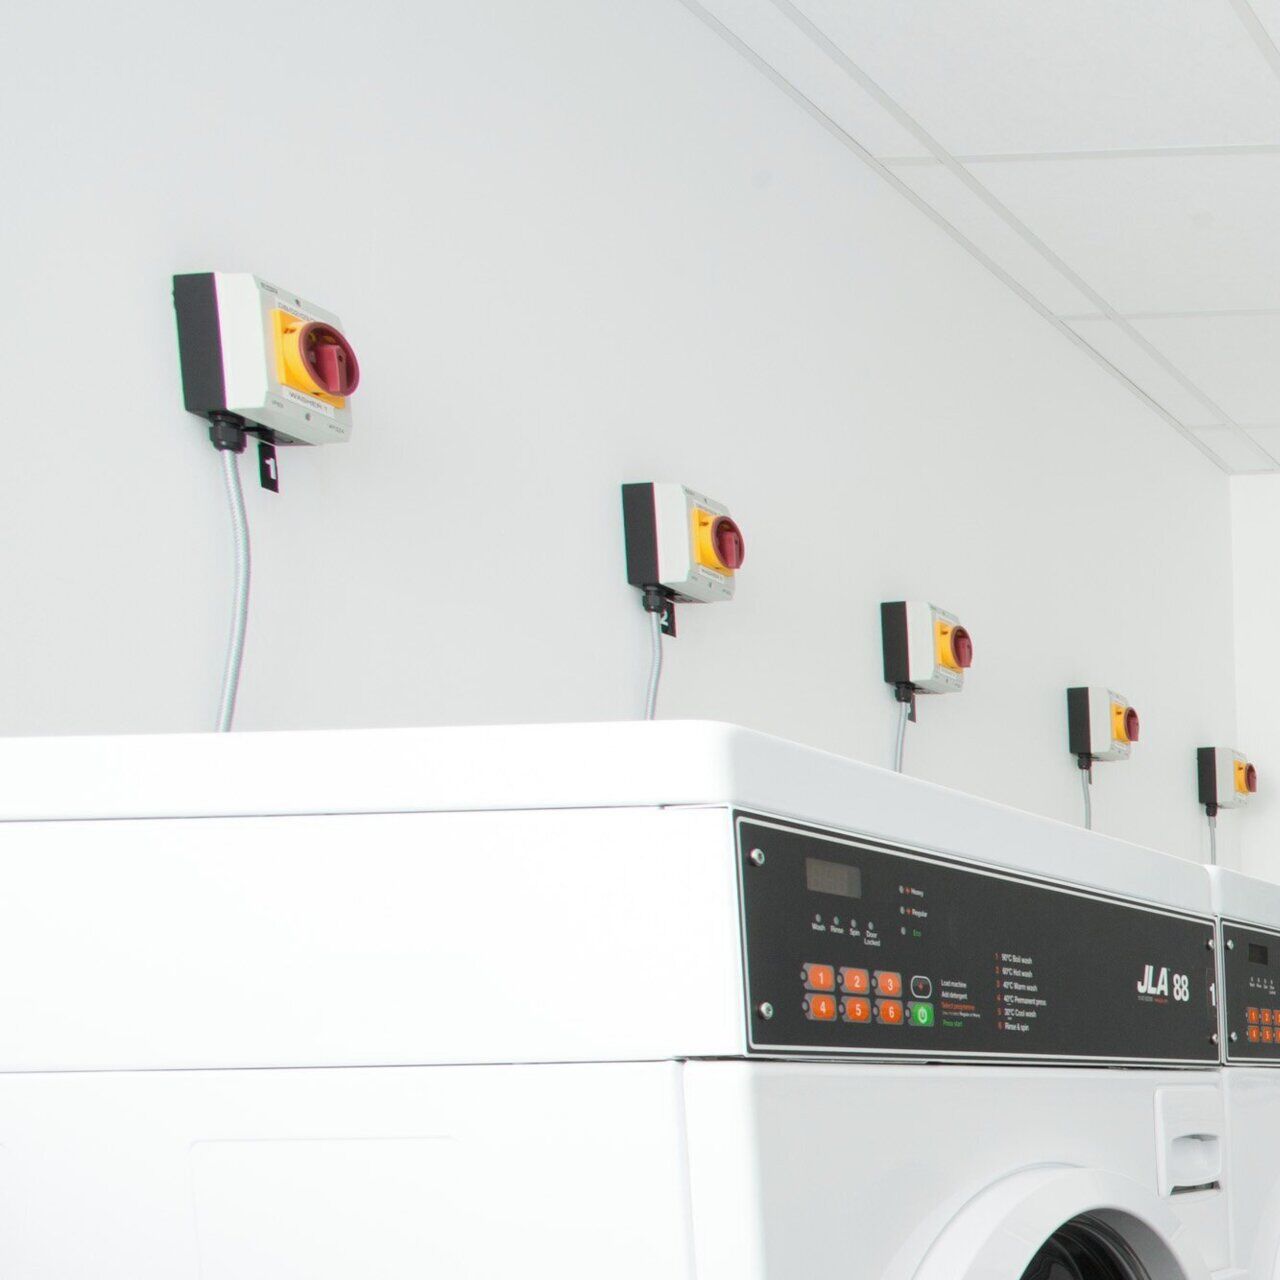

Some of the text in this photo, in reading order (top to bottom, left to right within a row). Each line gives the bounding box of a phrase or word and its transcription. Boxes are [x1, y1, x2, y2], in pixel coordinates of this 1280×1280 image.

[265, 457, 277, 480] 1
[660, 610, 669, 626] 2
[811, 922, 878, 938] Wash Rinse Spin Door
[819, 972, 894, 991] 1 2 3
[1021, 970, 1033, 978] wash
[1026, 984, 1038, 992] wash
[1137, 965, 1168, 996] JLA
[1173, 973, 1189, 1002] 88
[1209, 983, 1216, 1006] 1
[820, 1001, 895, 1019] 4 5 6
[1025, 1010, 1037, 1018] wash
